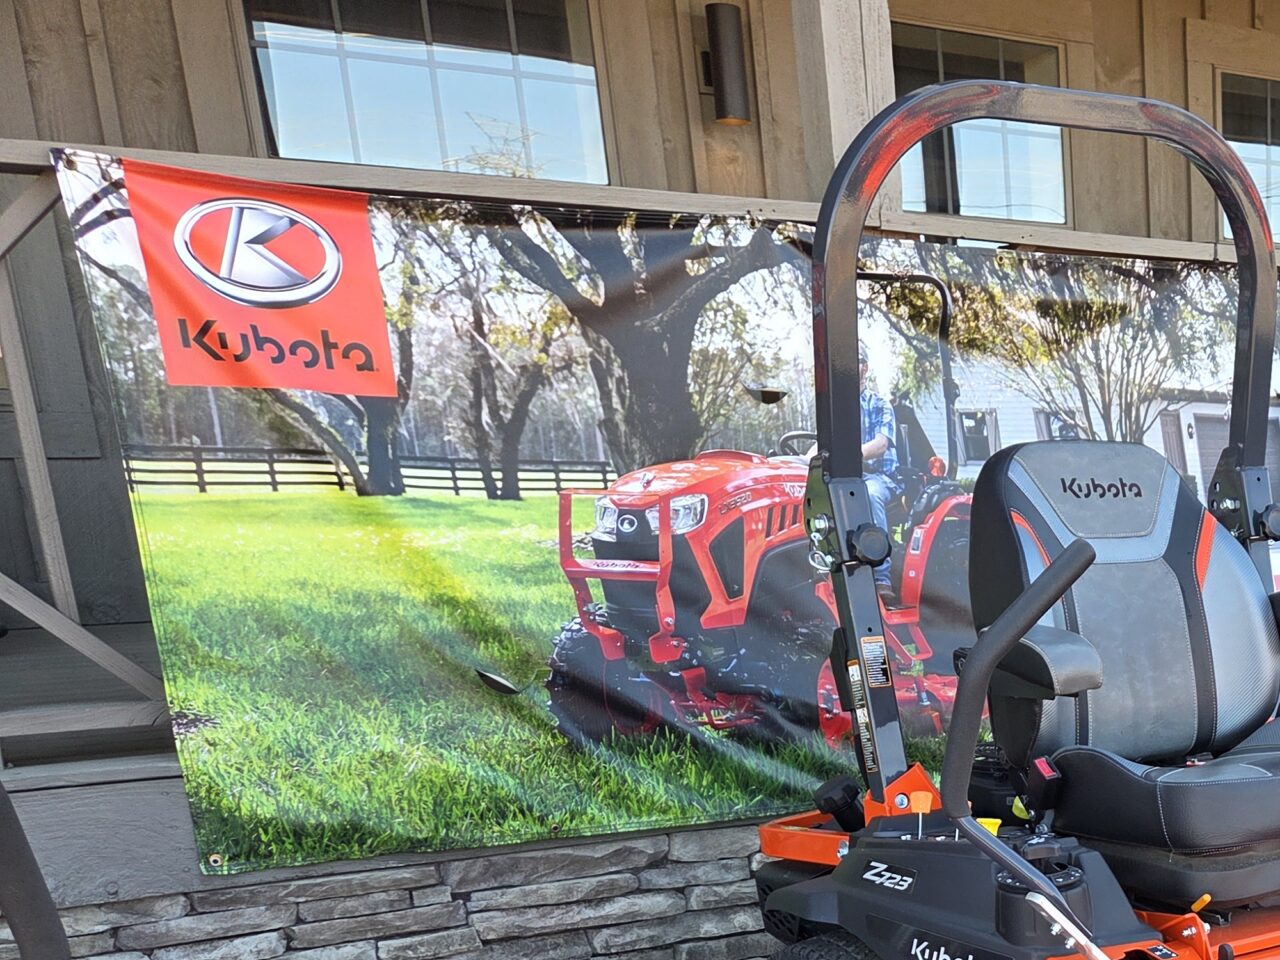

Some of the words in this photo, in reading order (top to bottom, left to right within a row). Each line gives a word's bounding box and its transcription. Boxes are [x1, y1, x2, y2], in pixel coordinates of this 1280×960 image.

[177, 318, 375, 372] Kubota
[1060, 477, 1143, 499] Kubota
[863, 861, 913, 891] Z723
